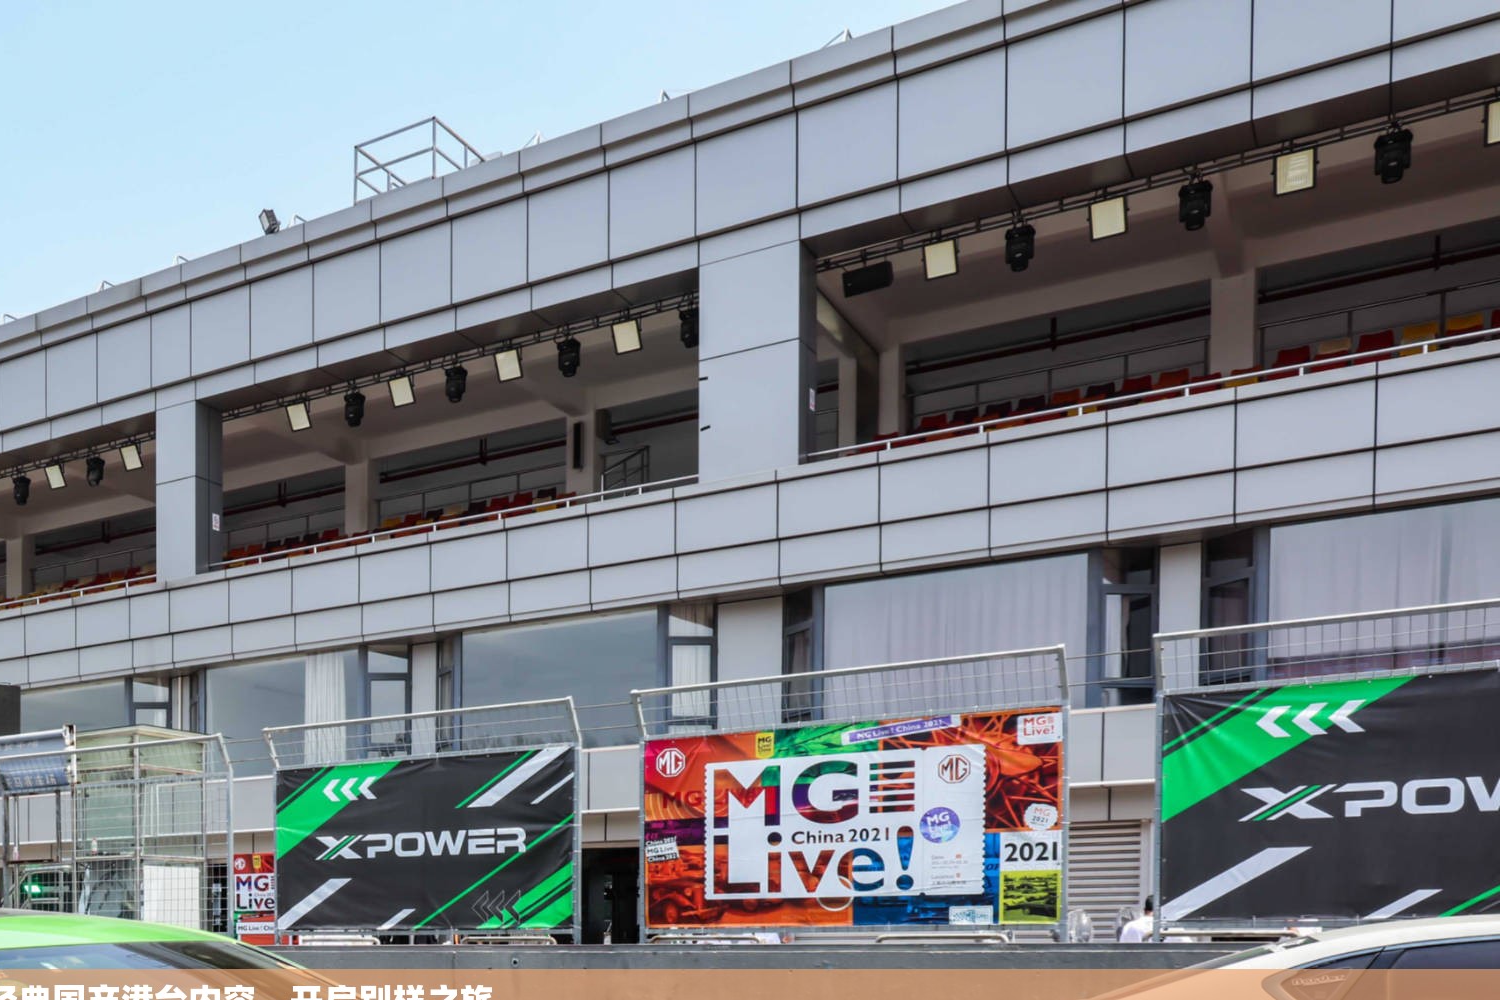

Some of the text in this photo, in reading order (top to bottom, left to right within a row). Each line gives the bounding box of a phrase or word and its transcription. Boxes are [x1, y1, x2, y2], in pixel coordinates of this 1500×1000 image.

[656, 748, 685, 777] MG
[938, 754, 971, 784] MG
[713, 760, 859, 828] MG
[315, 827, 527, 861] XPOWER
[791, 827, 890, 844] China 2021
[713, 826, 914, 894] Live!
[1004, 842, 1058, 862] 2021
[236, 875, 270, 892] MG
